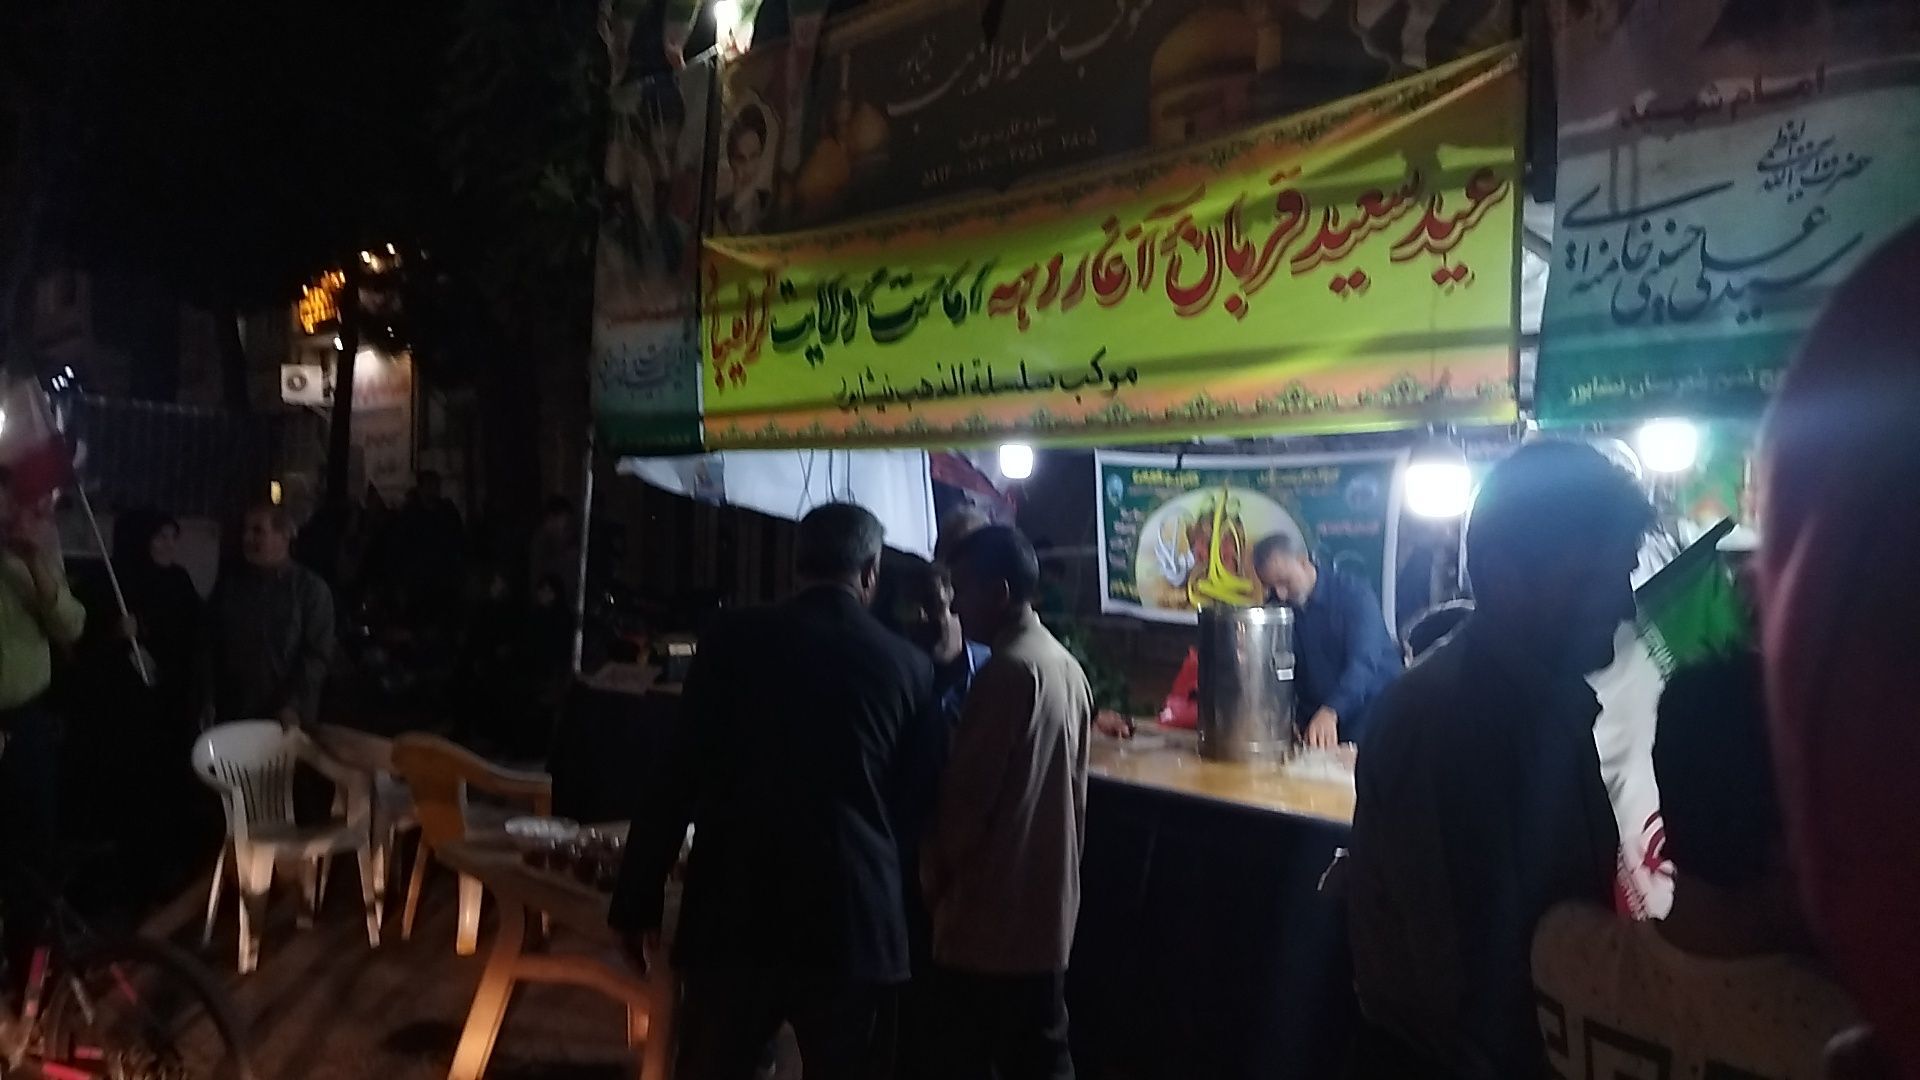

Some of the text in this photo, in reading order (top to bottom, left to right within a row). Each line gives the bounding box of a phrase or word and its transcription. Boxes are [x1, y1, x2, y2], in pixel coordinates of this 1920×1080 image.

[1162, 164, 1306, 318] قربان
[1291, 169, 1421, 292] سعید
[1391, 167, 1510, 292] عید
[1055, 346, 1139, 406] موکب
